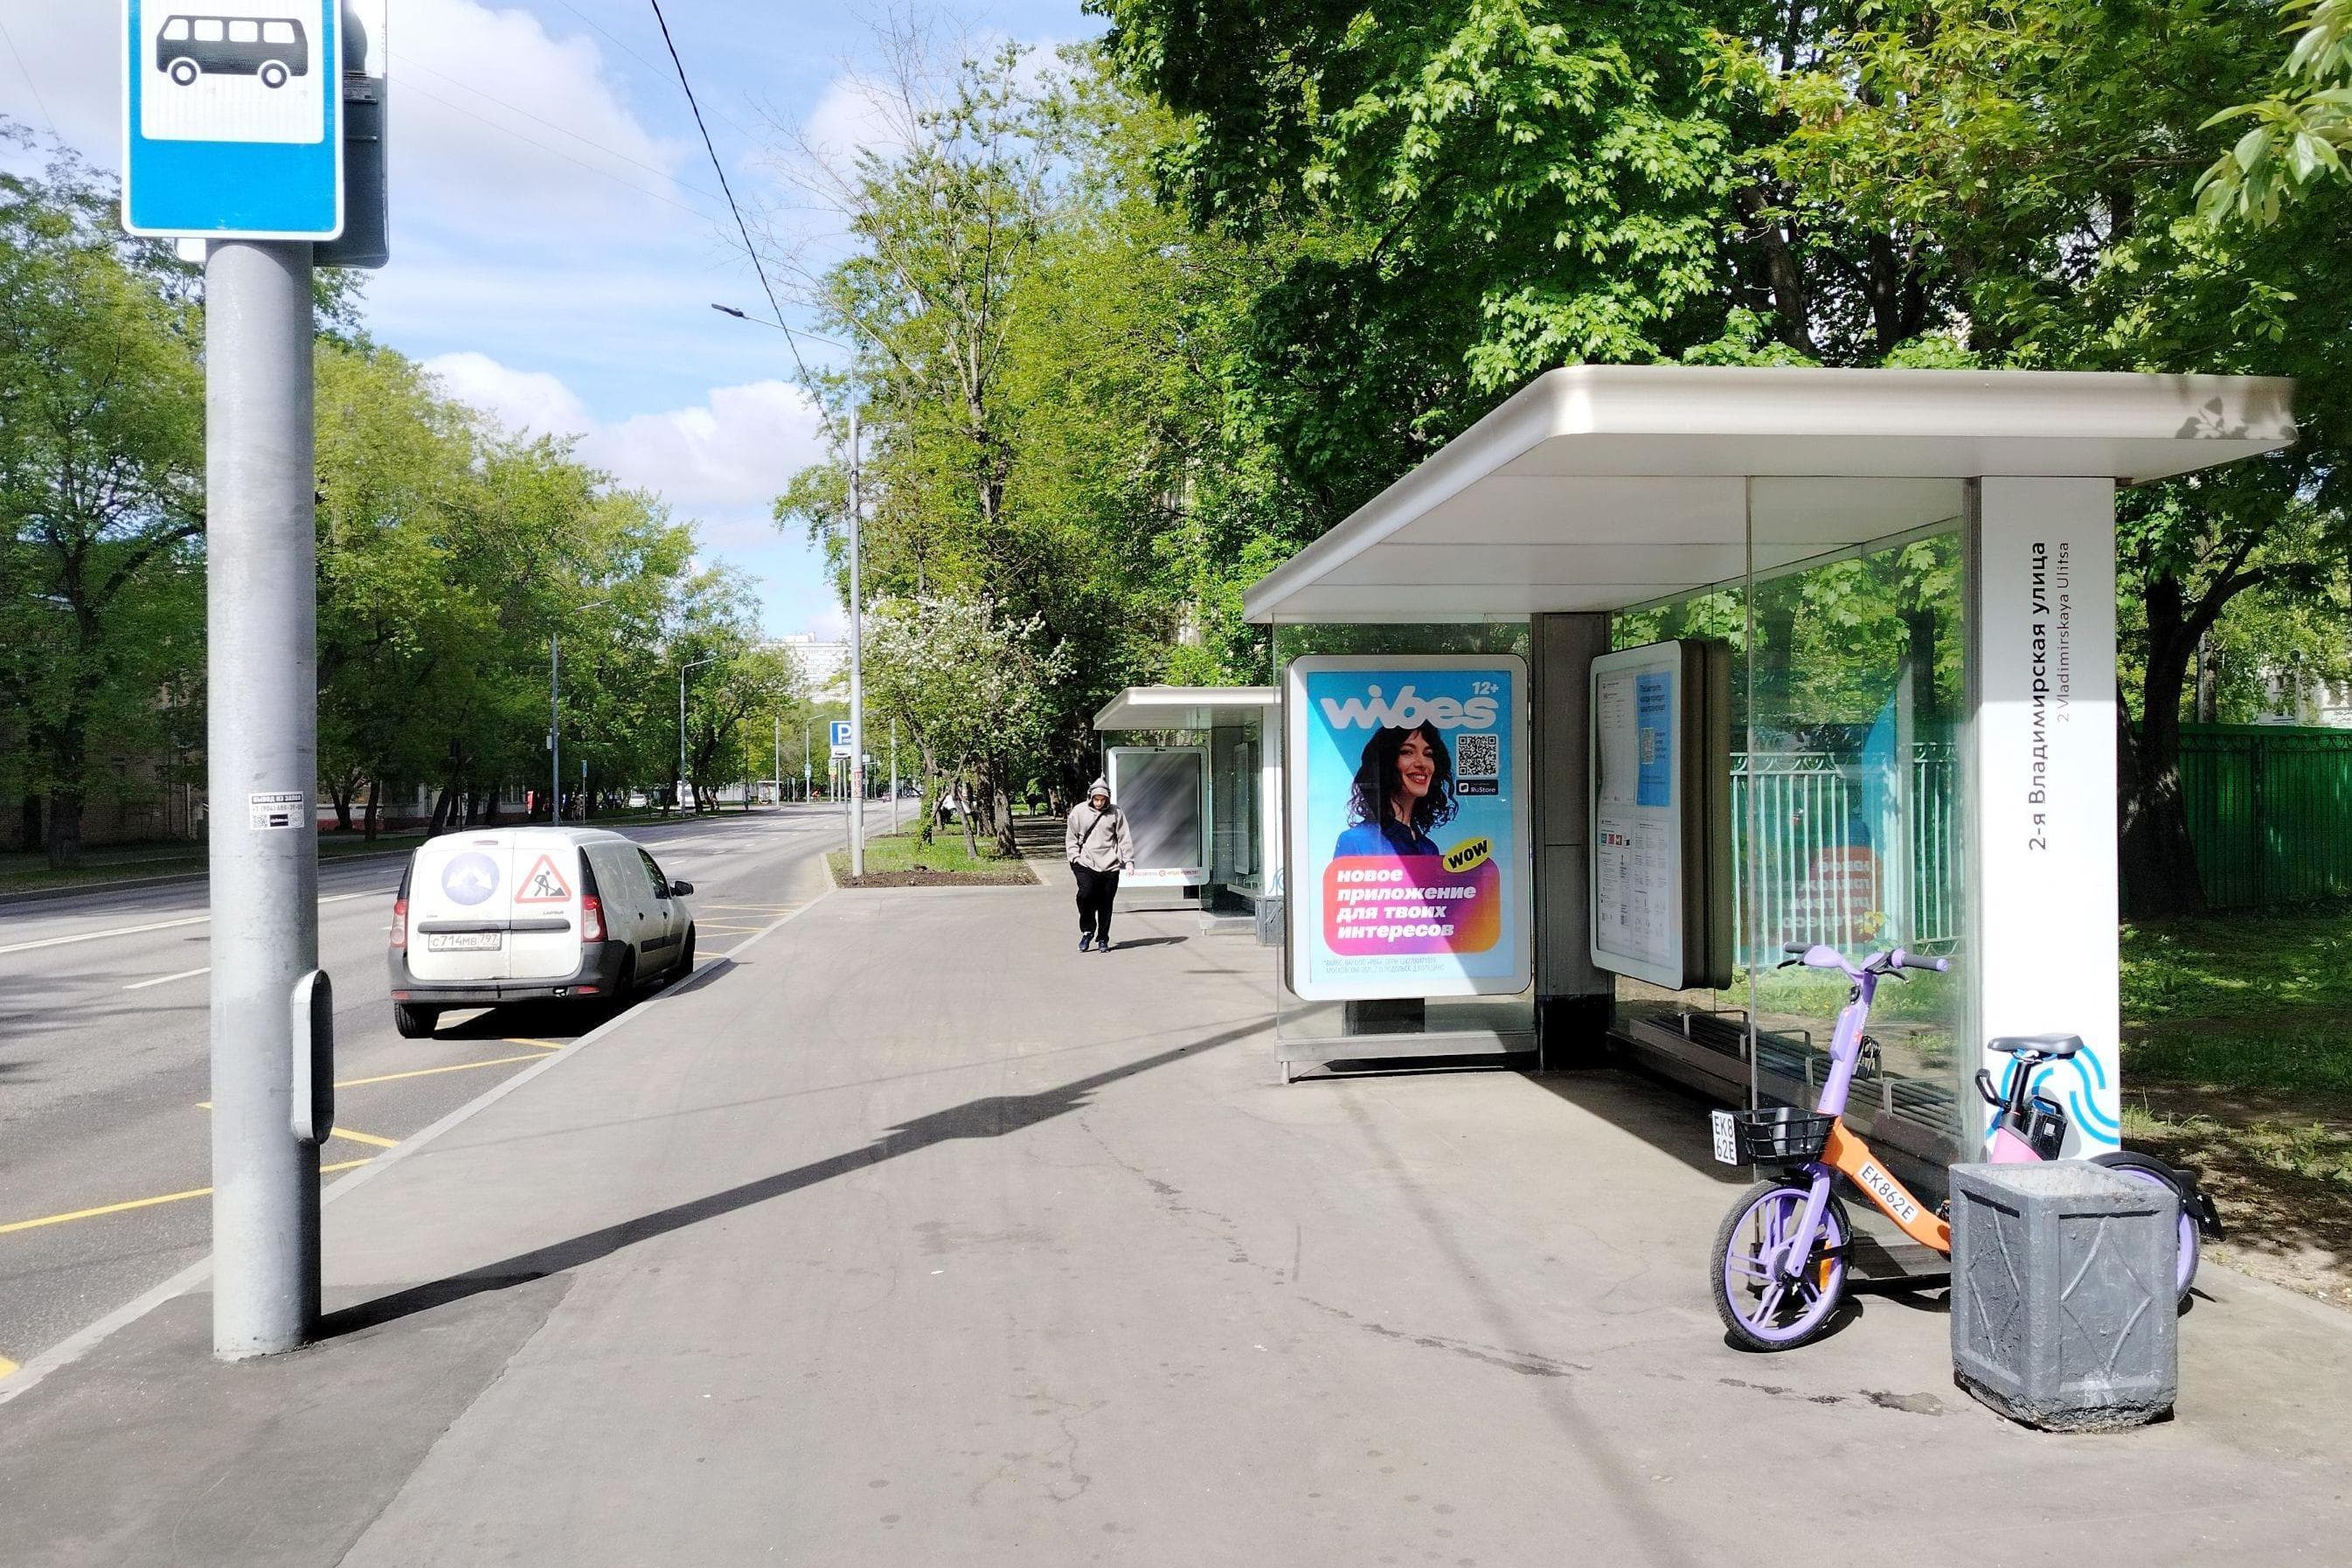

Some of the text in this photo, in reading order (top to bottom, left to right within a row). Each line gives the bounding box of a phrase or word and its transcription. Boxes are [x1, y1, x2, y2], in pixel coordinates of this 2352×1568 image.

[2057, 542, 2072, 723] 2 Vladimirskaya Ulitsa
[1472, 682, 1499, 695] 12+
[2029, 542, 2050, 850] 2-я Владимирская улица
[1337, 869, 1403, 883] новое
[1337, 886, 1476, 906] приложение
[1336, 905, 1447, 924] для твоих
[1337, 923, 1454, 942] интересов
